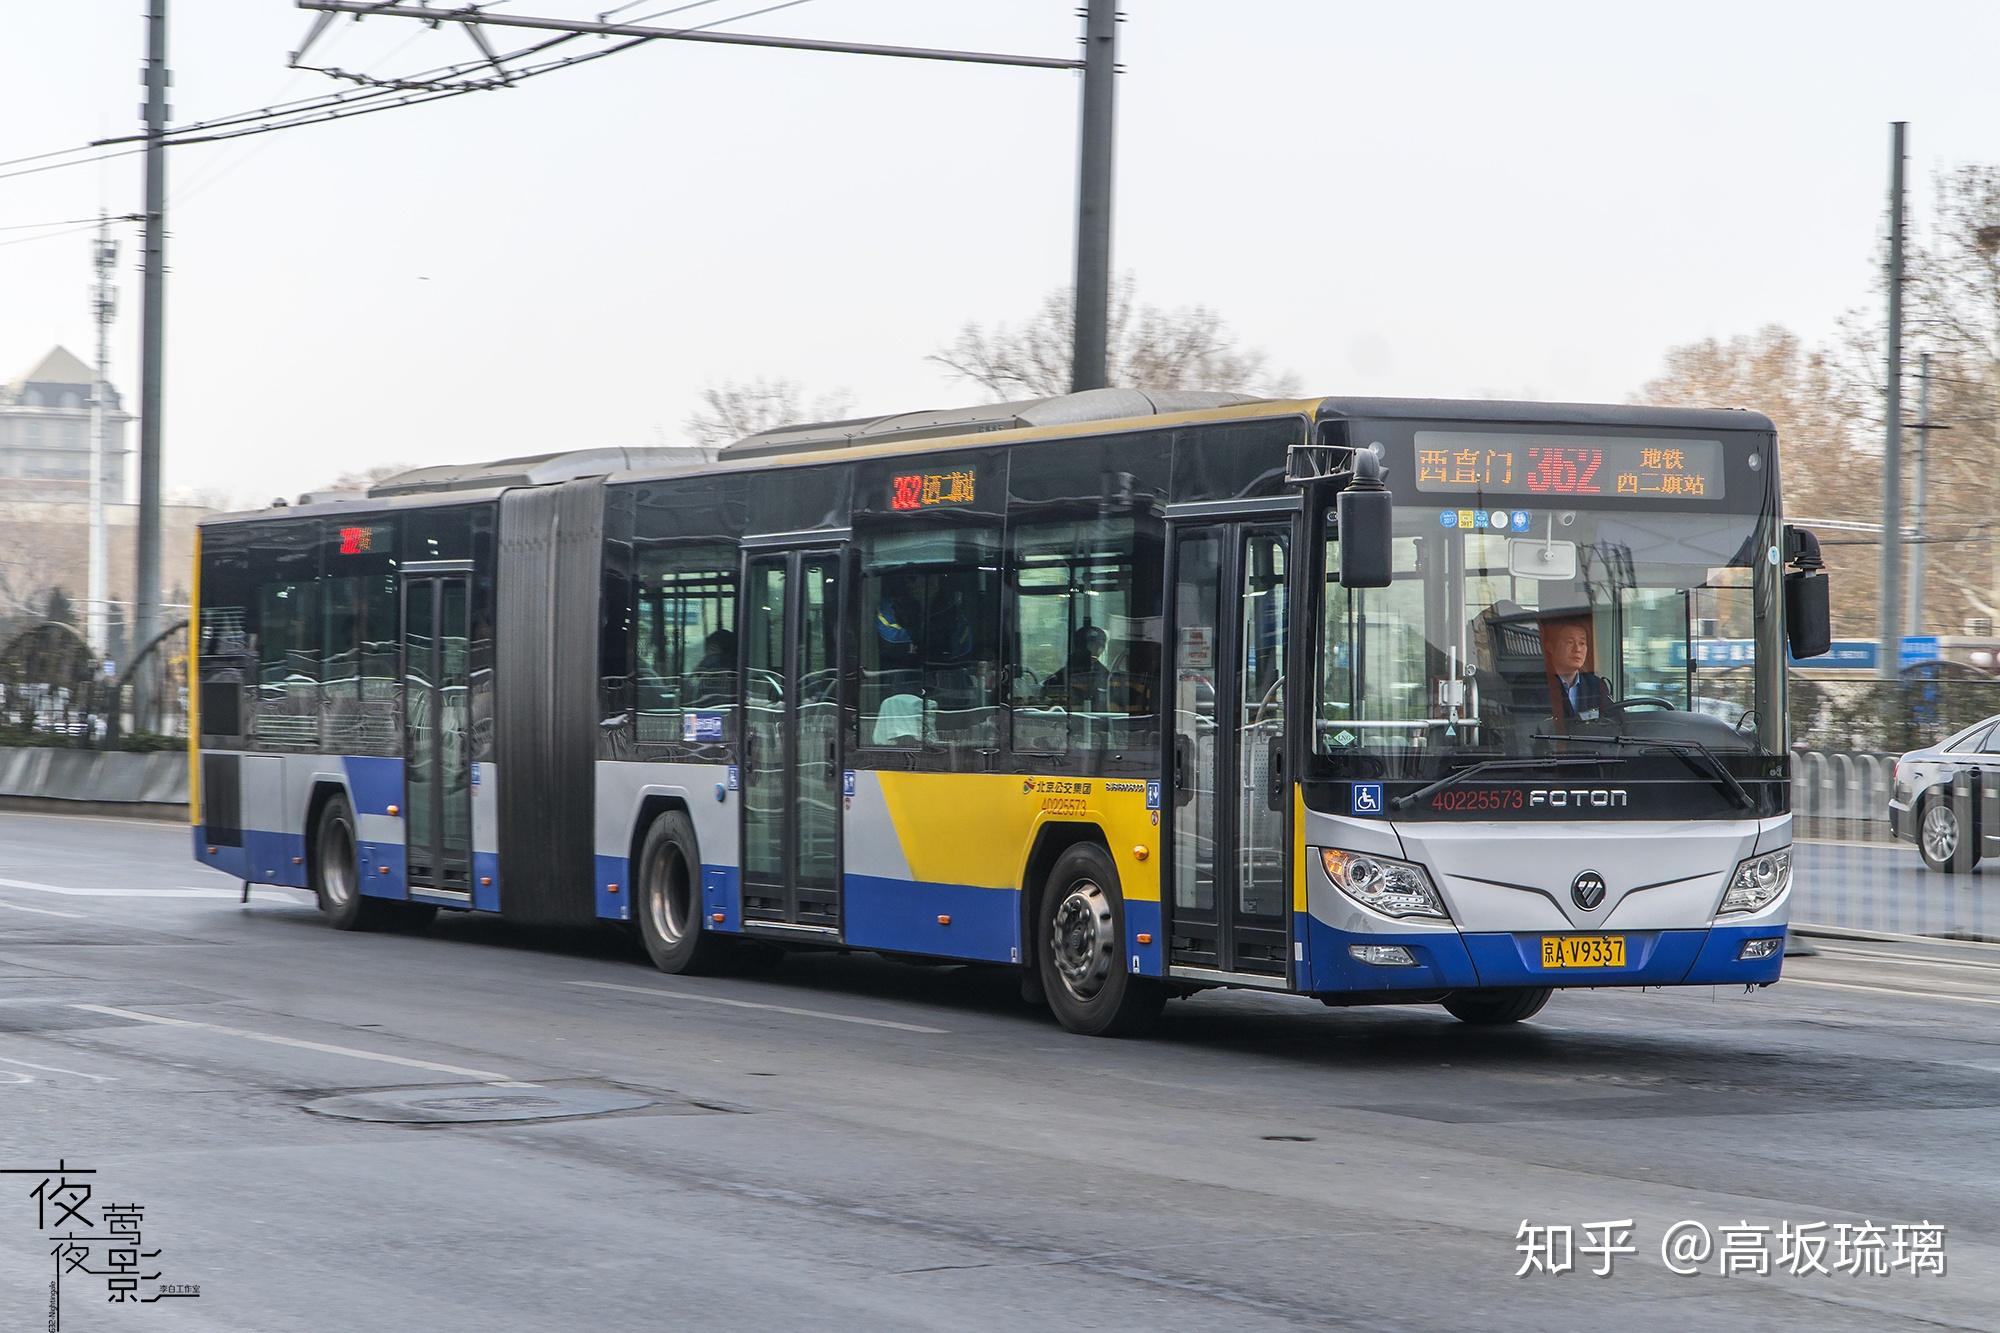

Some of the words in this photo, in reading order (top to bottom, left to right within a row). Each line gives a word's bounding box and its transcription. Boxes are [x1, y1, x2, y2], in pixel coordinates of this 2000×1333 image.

[1640, 447, 1685, 470] 地铁
[1526, 447, 1602, 493] 362
[890, 475, 922, 510] 362
[1036, 782, 1091, 794] 北京公交集团
[1529, 789, 1628, 807] FOTON
[1041, 798, 1087, 816] 40225573
[1431, 789, 1524, 811] 40225573
